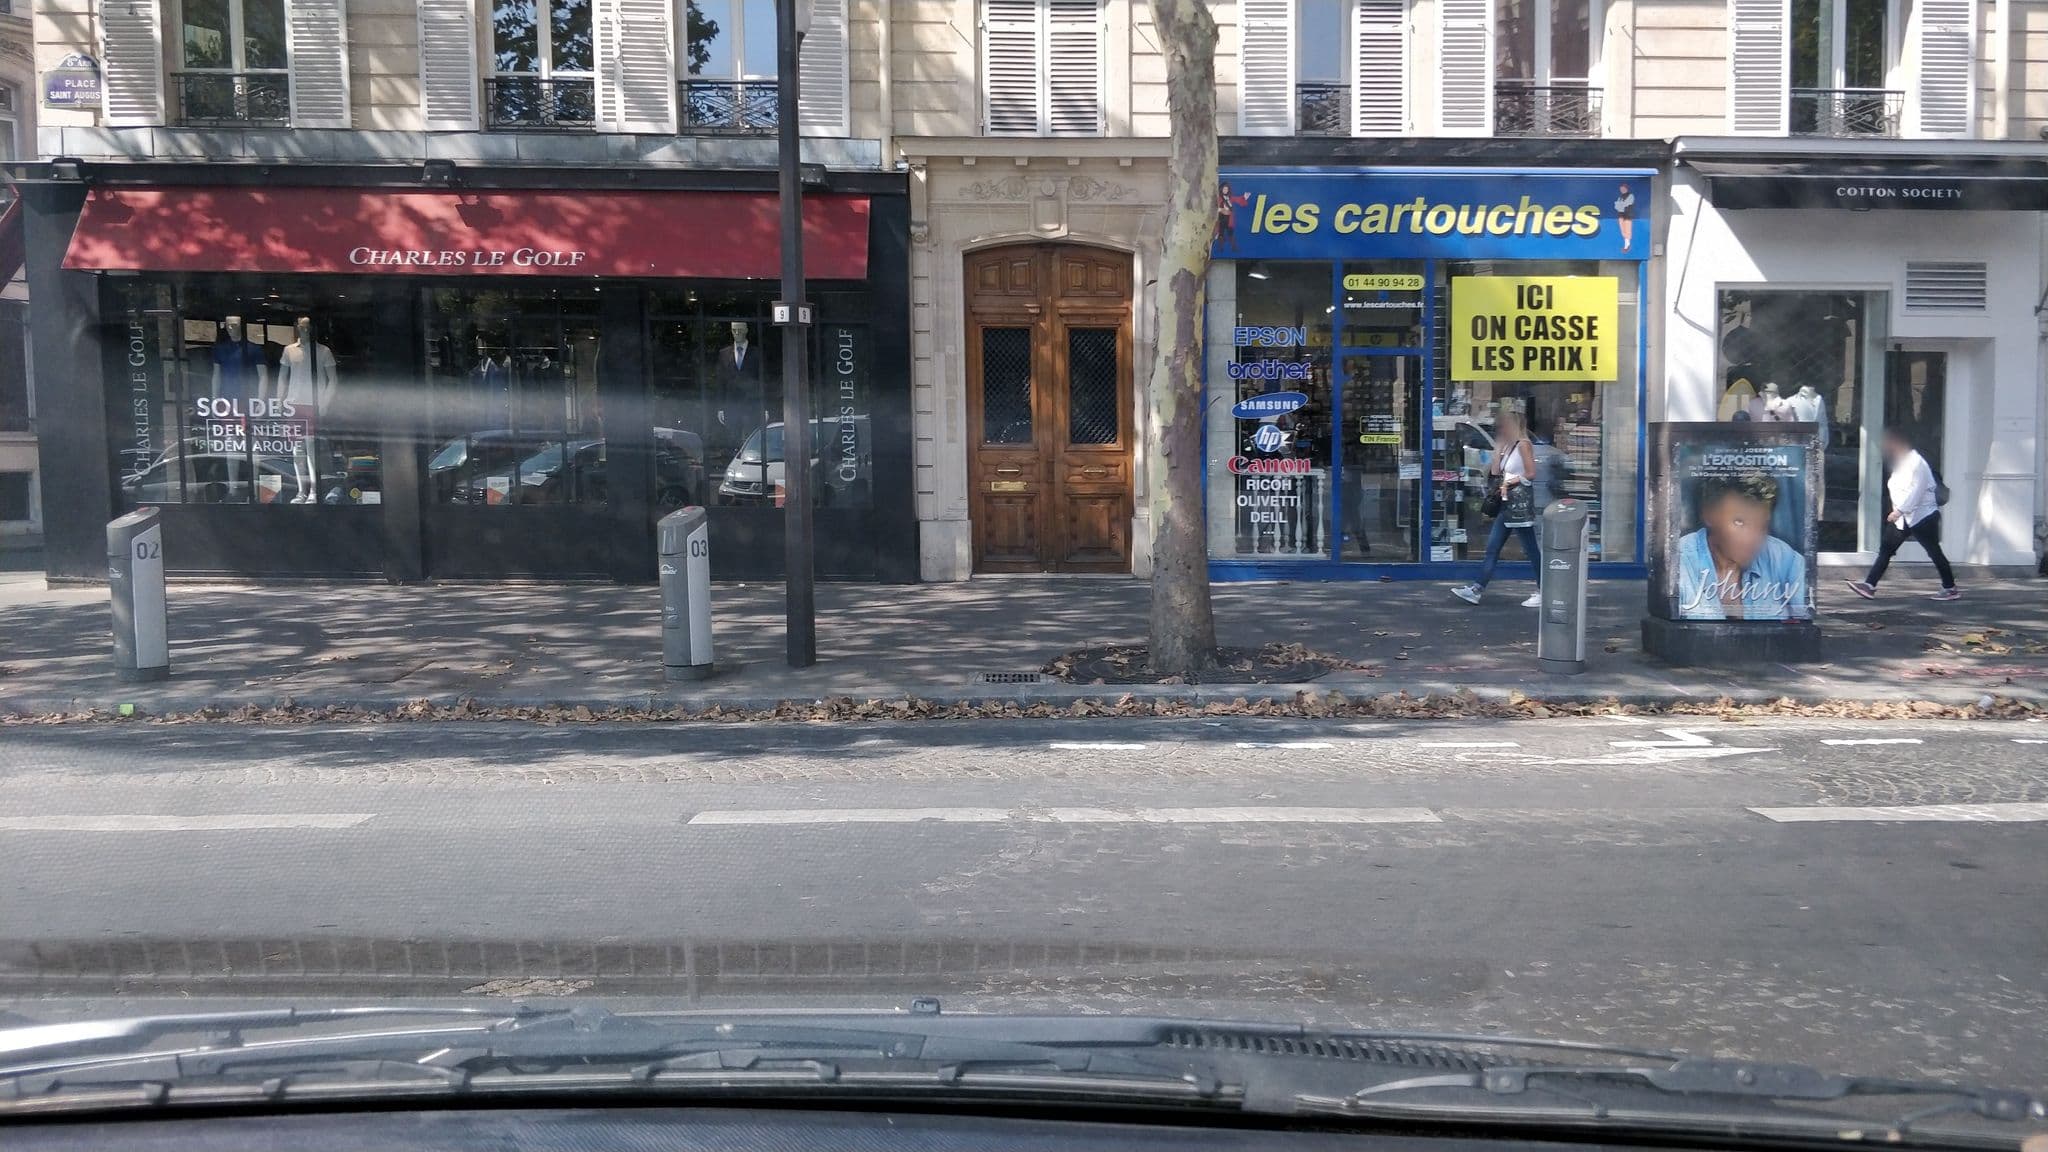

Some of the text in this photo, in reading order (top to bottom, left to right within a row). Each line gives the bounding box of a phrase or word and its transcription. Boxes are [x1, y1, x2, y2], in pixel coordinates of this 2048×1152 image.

[65, 79, 96, 88] PLACE
[49, 91, 72, 99] SAINT
[1836, 187, 1963, 198] COTTON SOCIETY
[1250, 194, 1601, 236] les cartouches
[349, 246, 586, 267] CHARLES LE GOLF
[1348, 278, 1420, 287] 01 44 90 94 28
[1516, 284, 1553, 310] ICI
[1232, 326, 1307, 347] EPSON
[1471, 315, 1599, 341] ON CASSE
[129, 320, 146, 367] GOLF
[1471, 345, 1599, 371] LES PRIX !
[1227, 359, 1312, 380] brother
[133, 372, 147, 392] LE
[196, 397, 296, 418] SOLDES
[836, 328, 857, 482] CHARLES LE GOLF
[1240, 401, 1299, 411] SAMSUNG
[212, 422, 303, 437] DERNIÈRE
[1258, 426, 1280, 452] hp
[213, 438, 304, 454] DÉMARQUE
[1226, 455, 1312, 475] Canon
[1702, 454, 1788, 466] L'EXPOSITION
[1246, 479, 1292, 491] RICOH
[1237, 495, 1301, 507] OLIVETTI
[1250, 511, 1289, 523] DELL
[136, 541, 161, 560] 02
[690, 539, 708, 558] 03
[1682, 568, 1801, 616] Johnny
